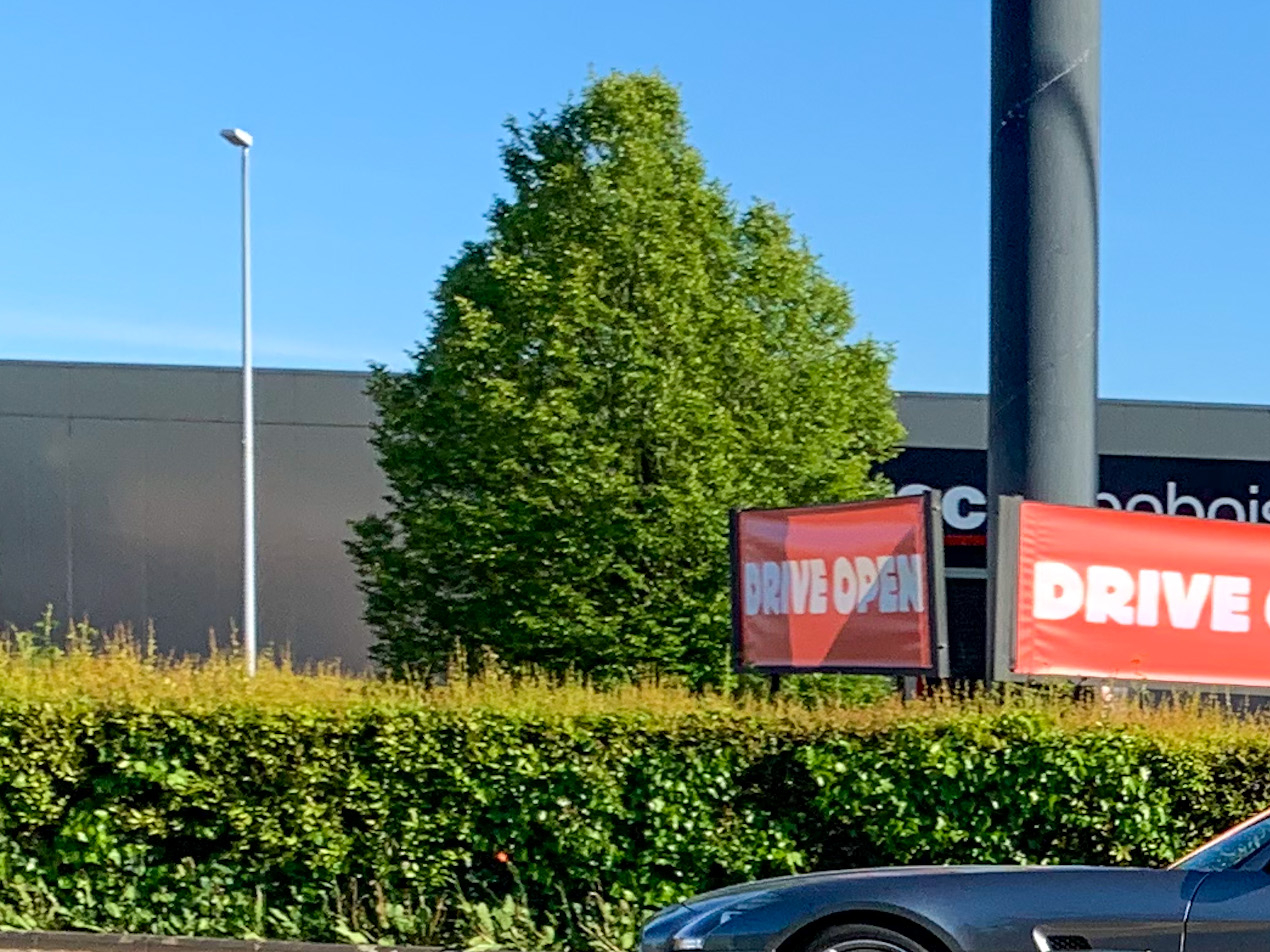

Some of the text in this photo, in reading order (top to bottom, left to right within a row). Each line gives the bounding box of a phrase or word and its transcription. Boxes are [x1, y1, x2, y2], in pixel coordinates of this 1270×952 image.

[744, 553, 924, 615] DRIVE OPEN
[1032, 561, 1251, 633] DRIVE
